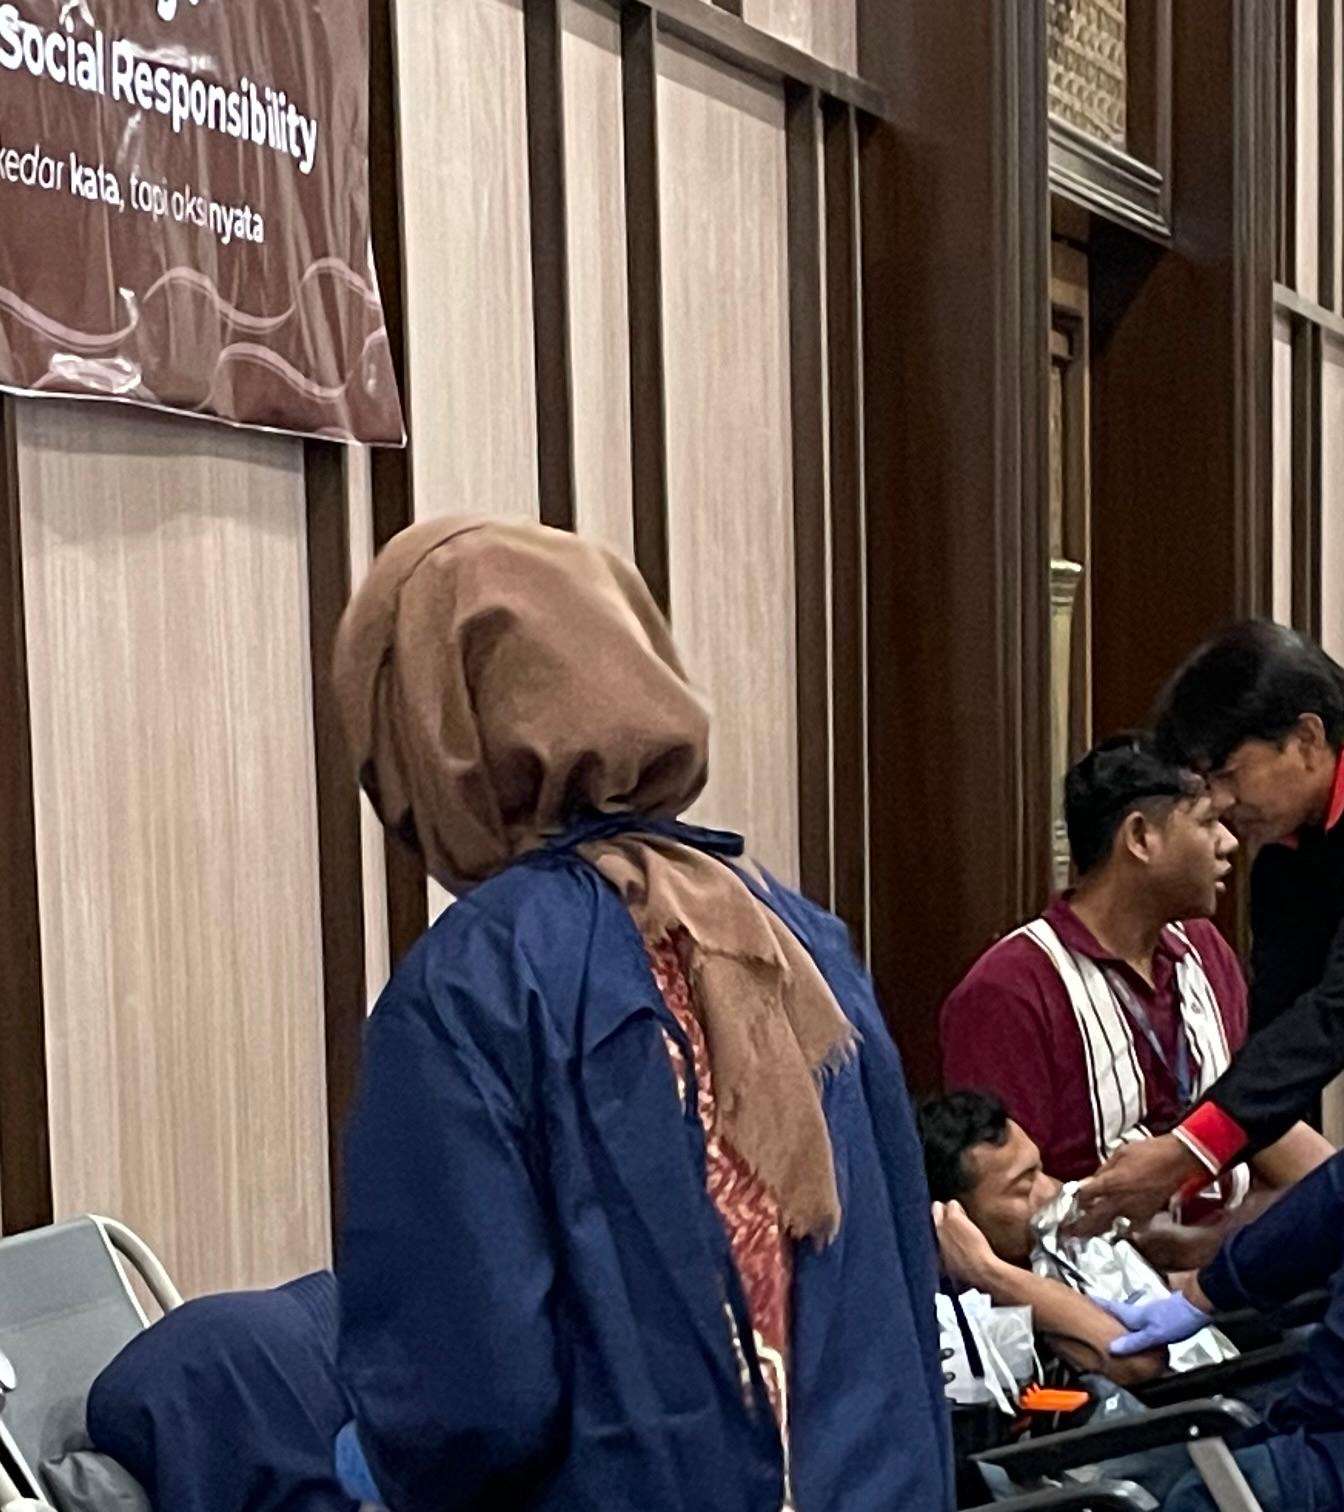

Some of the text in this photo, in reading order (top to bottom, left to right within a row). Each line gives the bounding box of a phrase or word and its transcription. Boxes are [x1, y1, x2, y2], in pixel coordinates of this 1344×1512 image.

[112, 39, 316, 174] Responsibility
[70, 152, 124, 213] kata,
[209, 202, 264, 244] nyata
